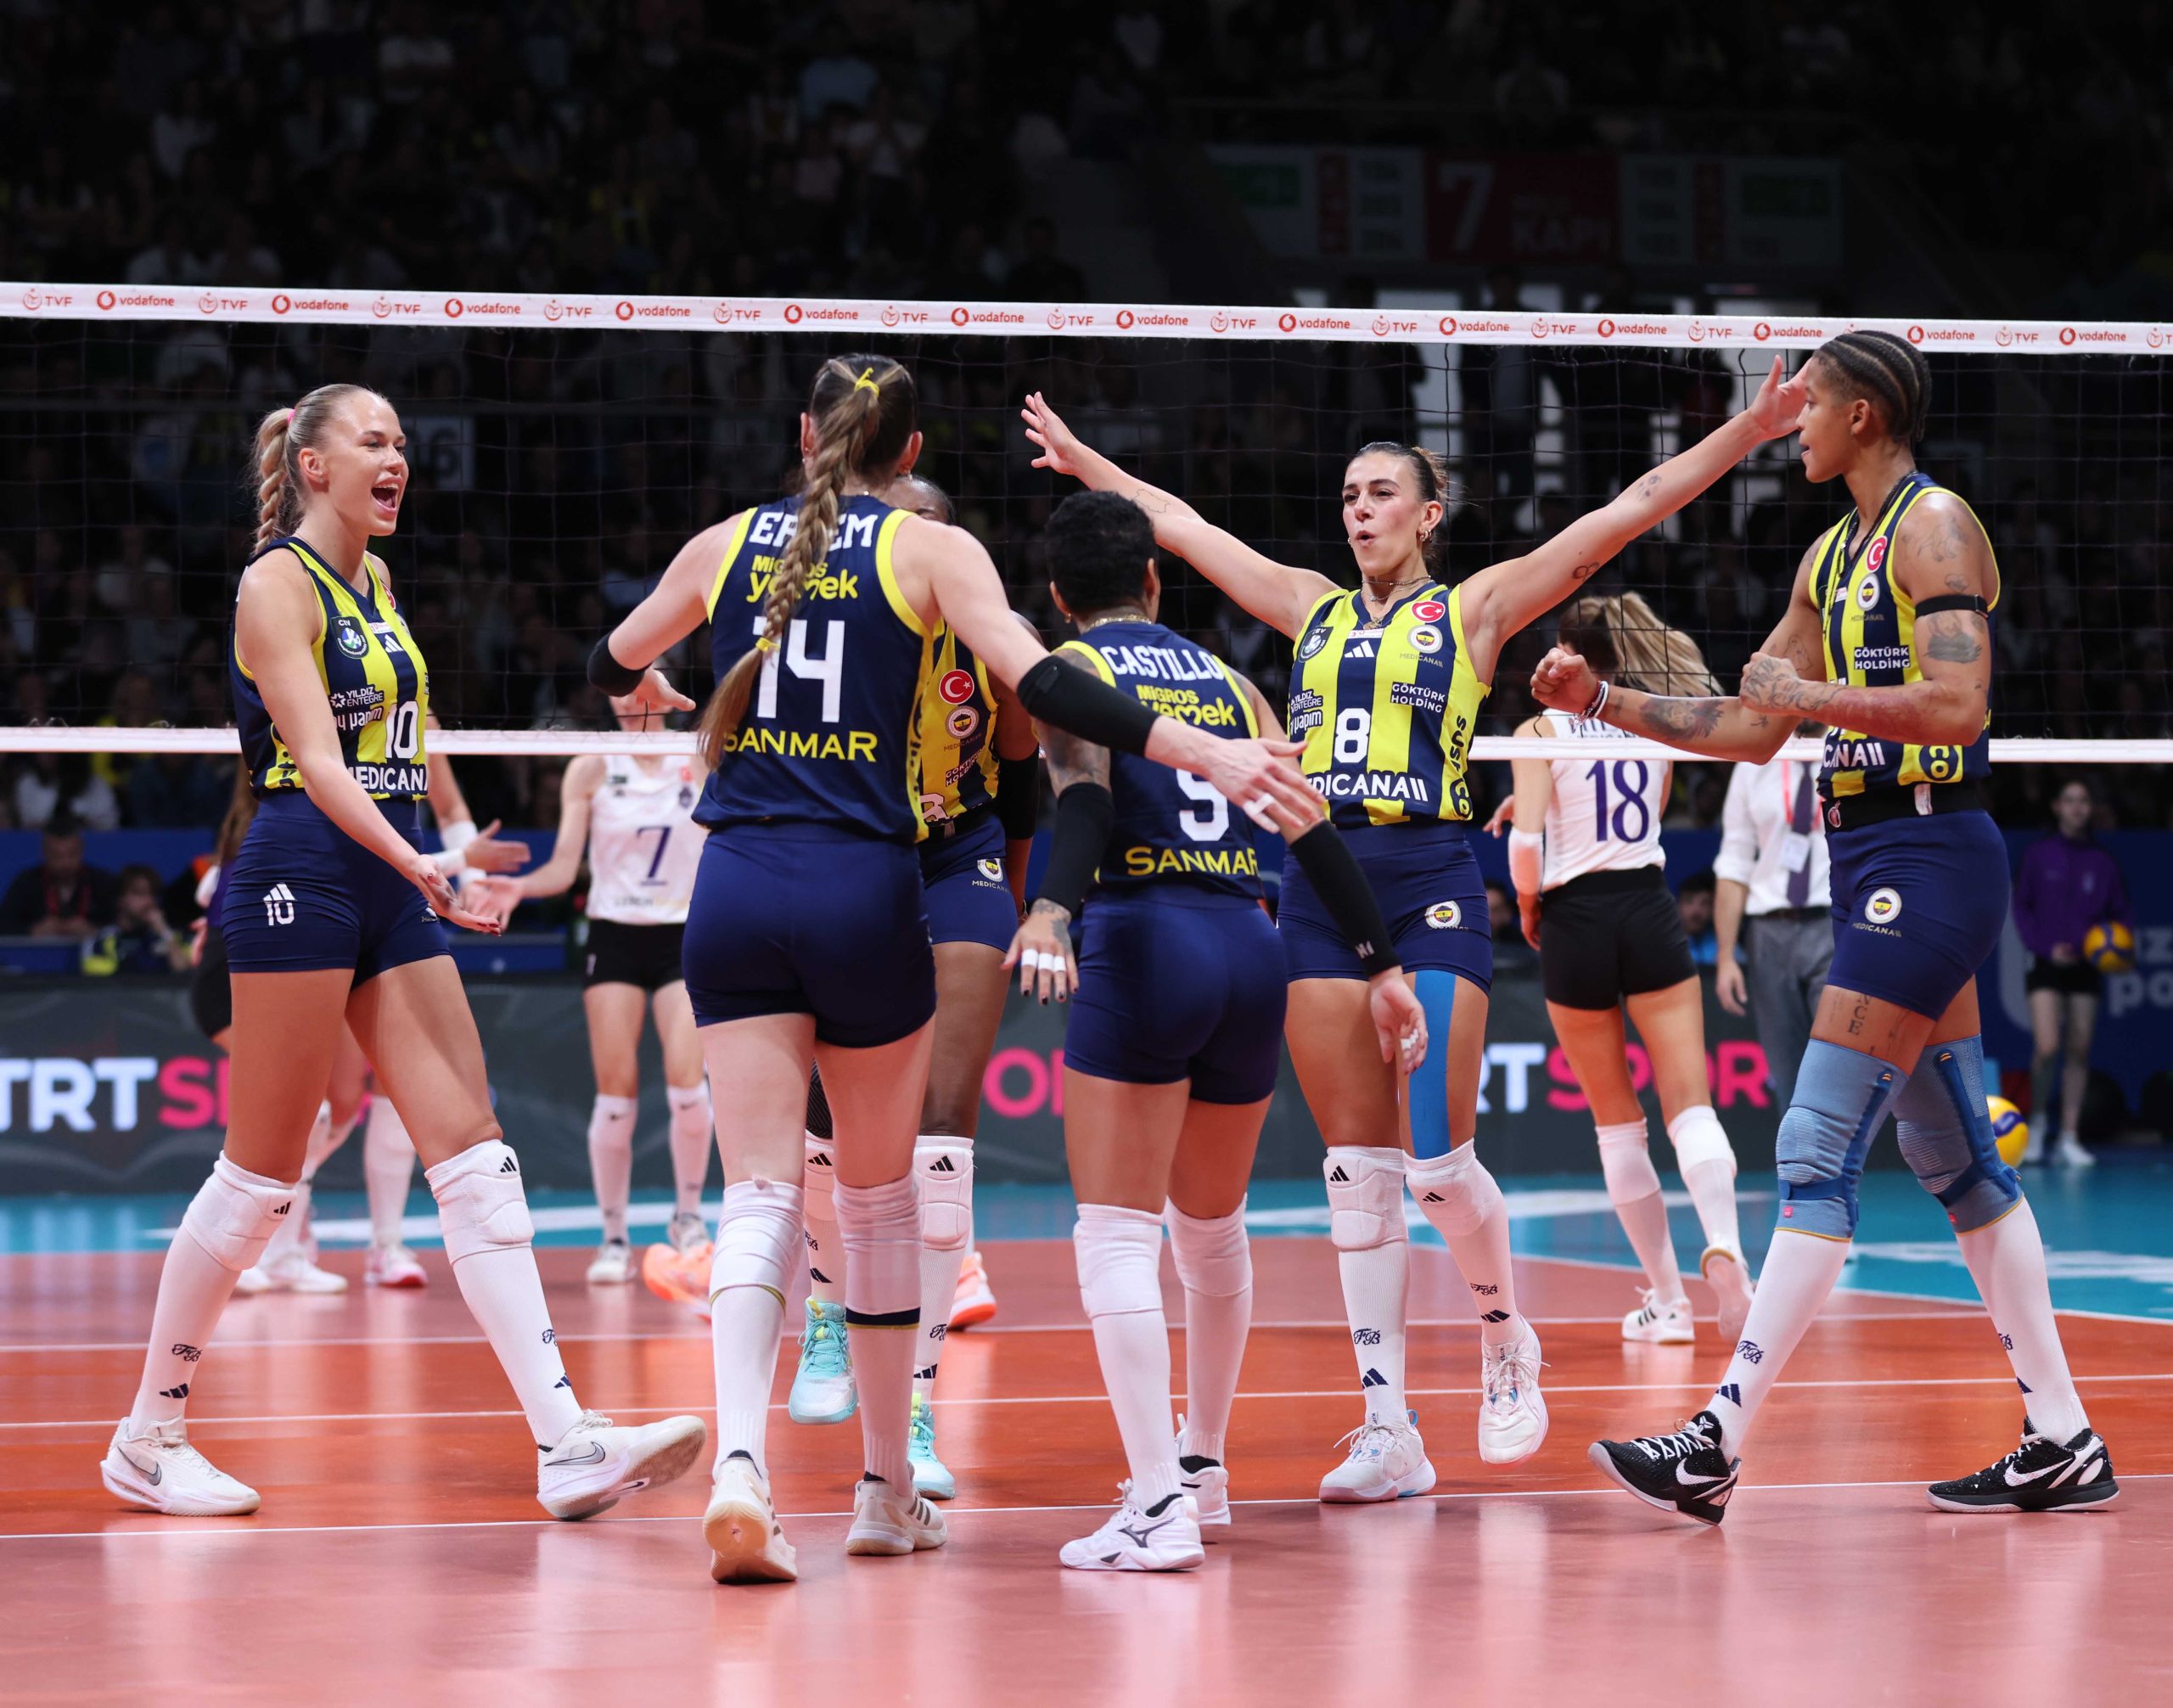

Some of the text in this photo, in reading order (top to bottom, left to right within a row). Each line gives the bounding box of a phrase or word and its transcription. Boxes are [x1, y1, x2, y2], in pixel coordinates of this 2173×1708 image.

[1437, 162, 1496, 254] 7
[45, 295, 2127, 343] TVF vodafone TVF vodafone TVF vodafone TVF vodafone TVF vodafone TVF vodafone TVF vodafone TVF vodafone TVF vodafone TVF vodafone TVF vodafone vodafone TVF vodafone
[752, 615, 845, 723] 14
[1100, 646, 1224, 681] CASTILLO
[1854, 645, 1909, 659] GÖKTÜRK
[1854, 657, 1911, 670] HOLDİNG
[346, 686, 374, 699] YILDIZ
[346, 693, 384, 707] ENTEGRE
[1390, 694, 1443, 714] HOLDİNG
[1392, 683, 1446, 704] GÖKTÜRK
[385, 700, 420, 759] 10
[1334, 707, 1372, 763] 8
[1306, 773, 1411, 799] DICANA
[1586, 760, 1649, 843] 18
[636, 826, 672, 887] 7
